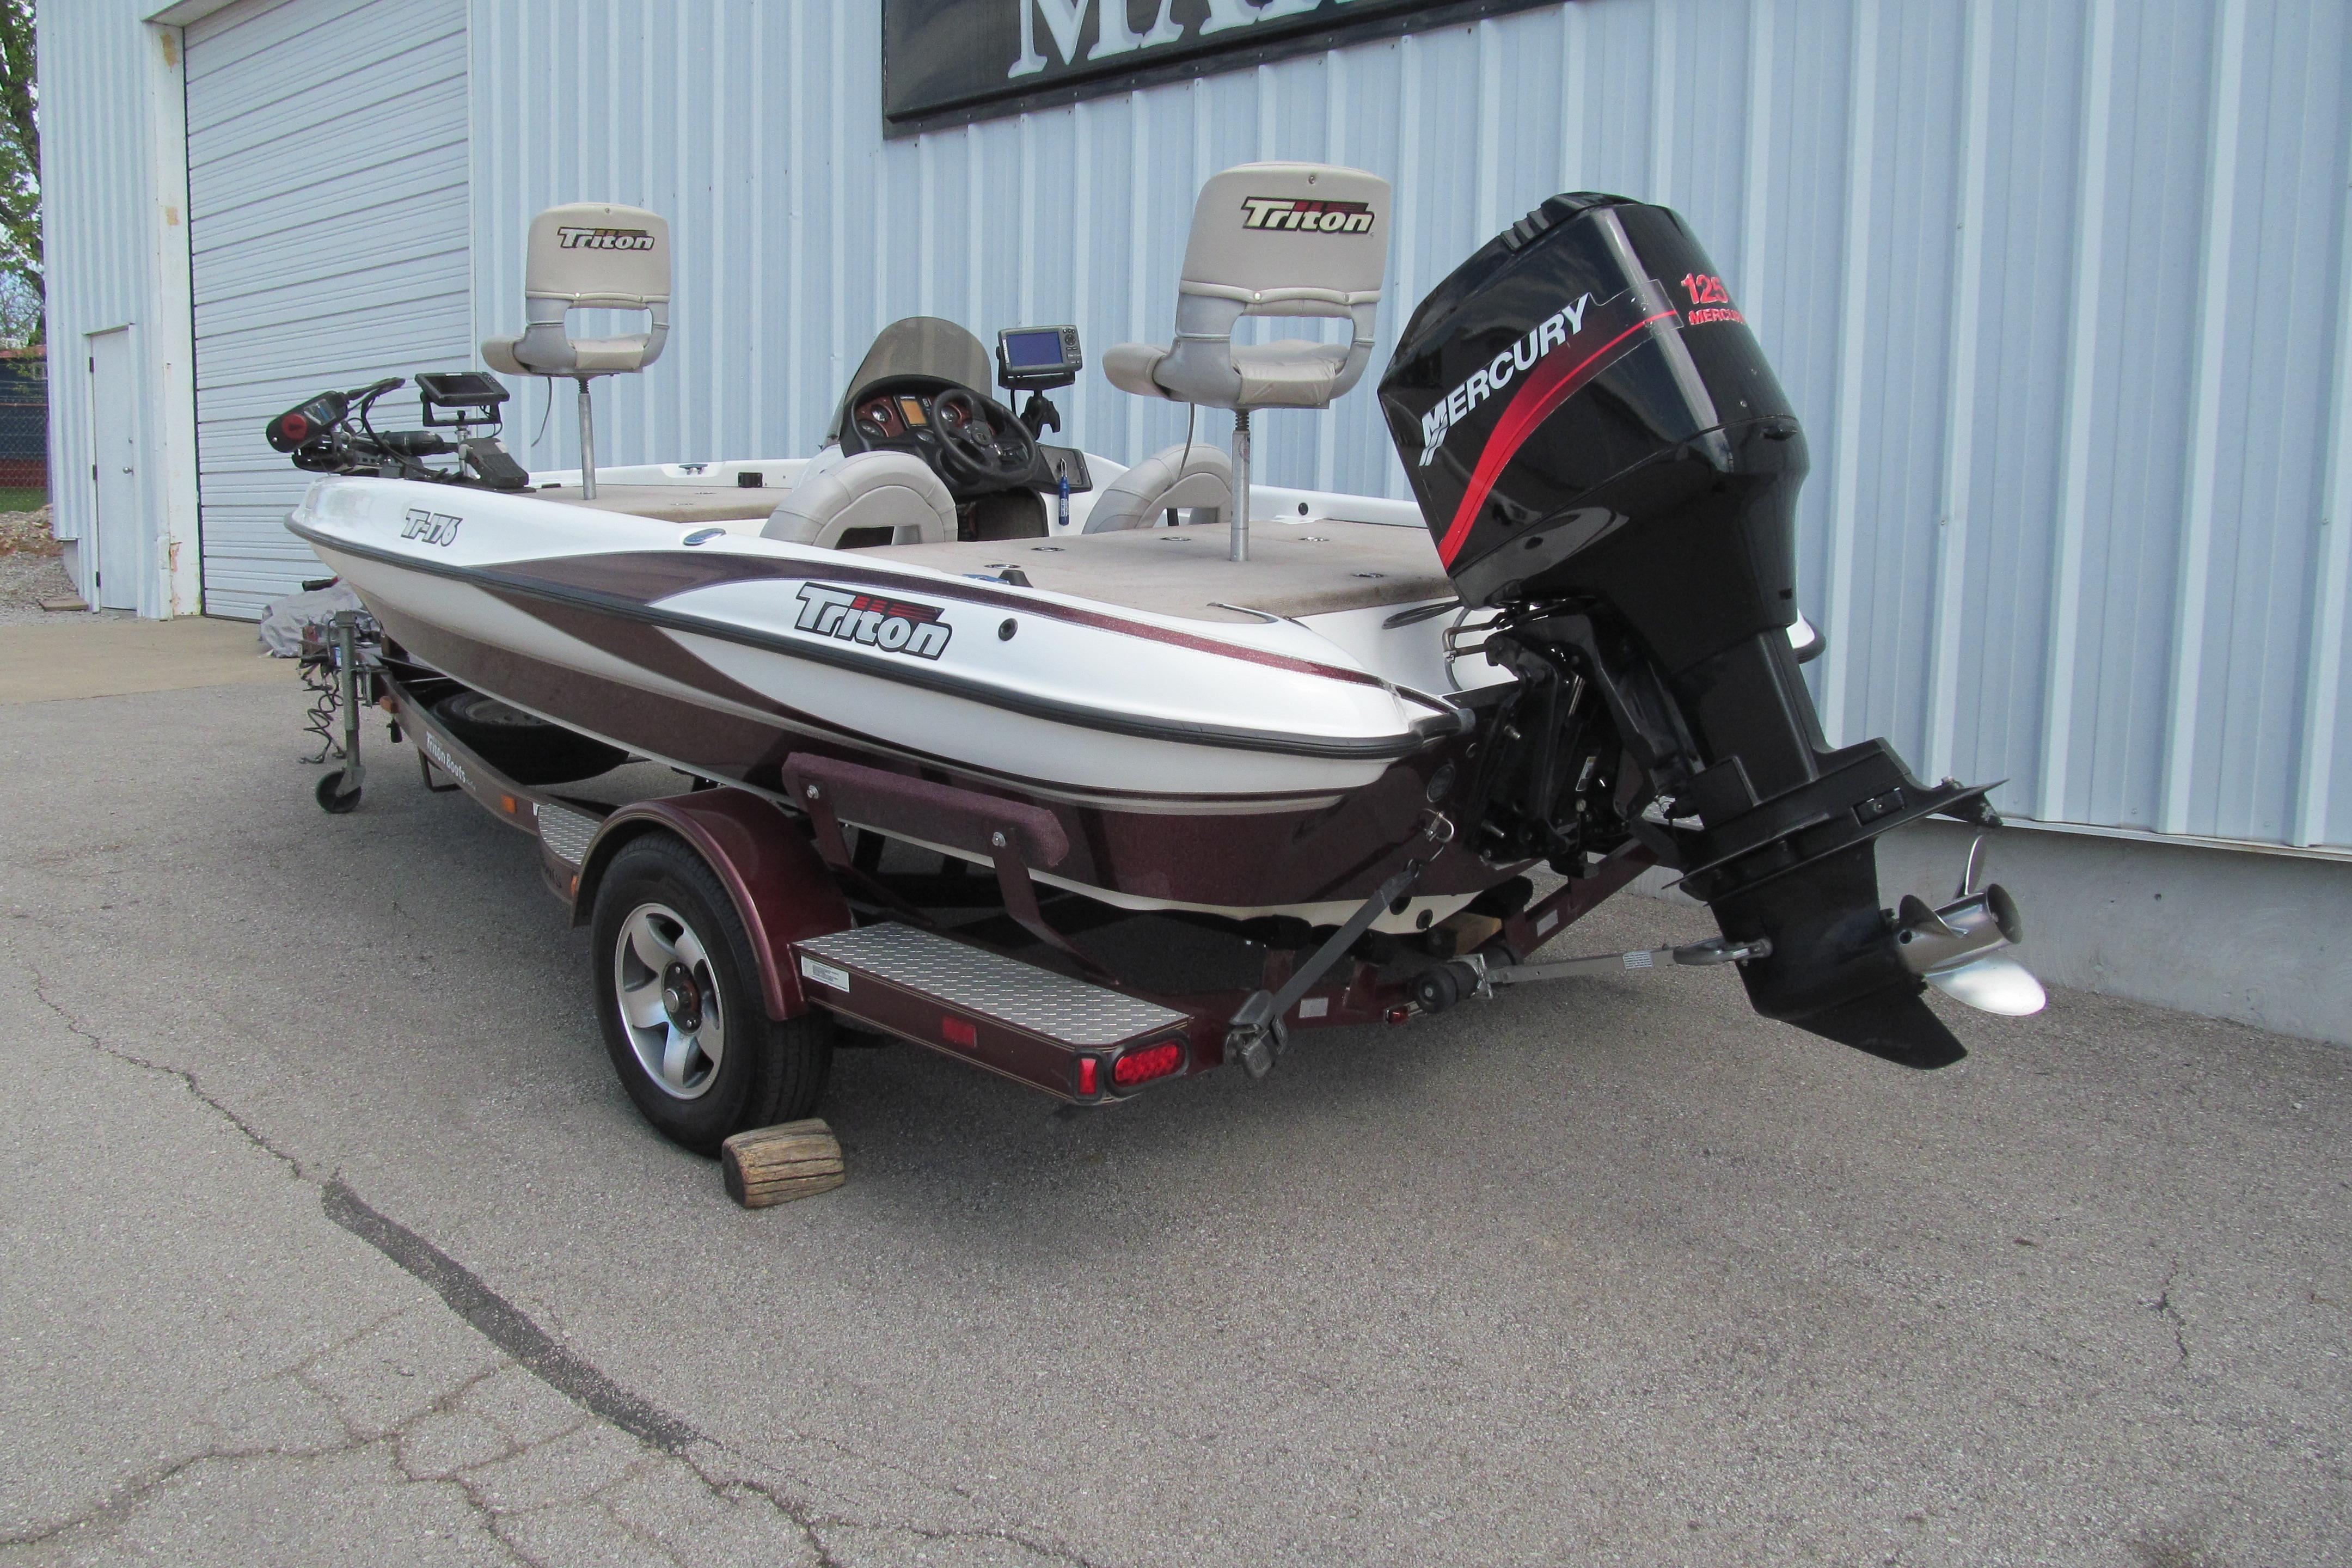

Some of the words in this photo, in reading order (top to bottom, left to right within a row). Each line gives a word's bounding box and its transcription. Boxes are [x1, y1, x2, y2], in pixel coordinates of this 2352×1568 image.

[1241, 196, 1375, 234] Triton
[557, 226, 655, 251] Triton
[1681, 273, 1729, 304] 125
[1419, 292, 1589, 466] MERCURY
[794, 581, 953, 660] Triton
